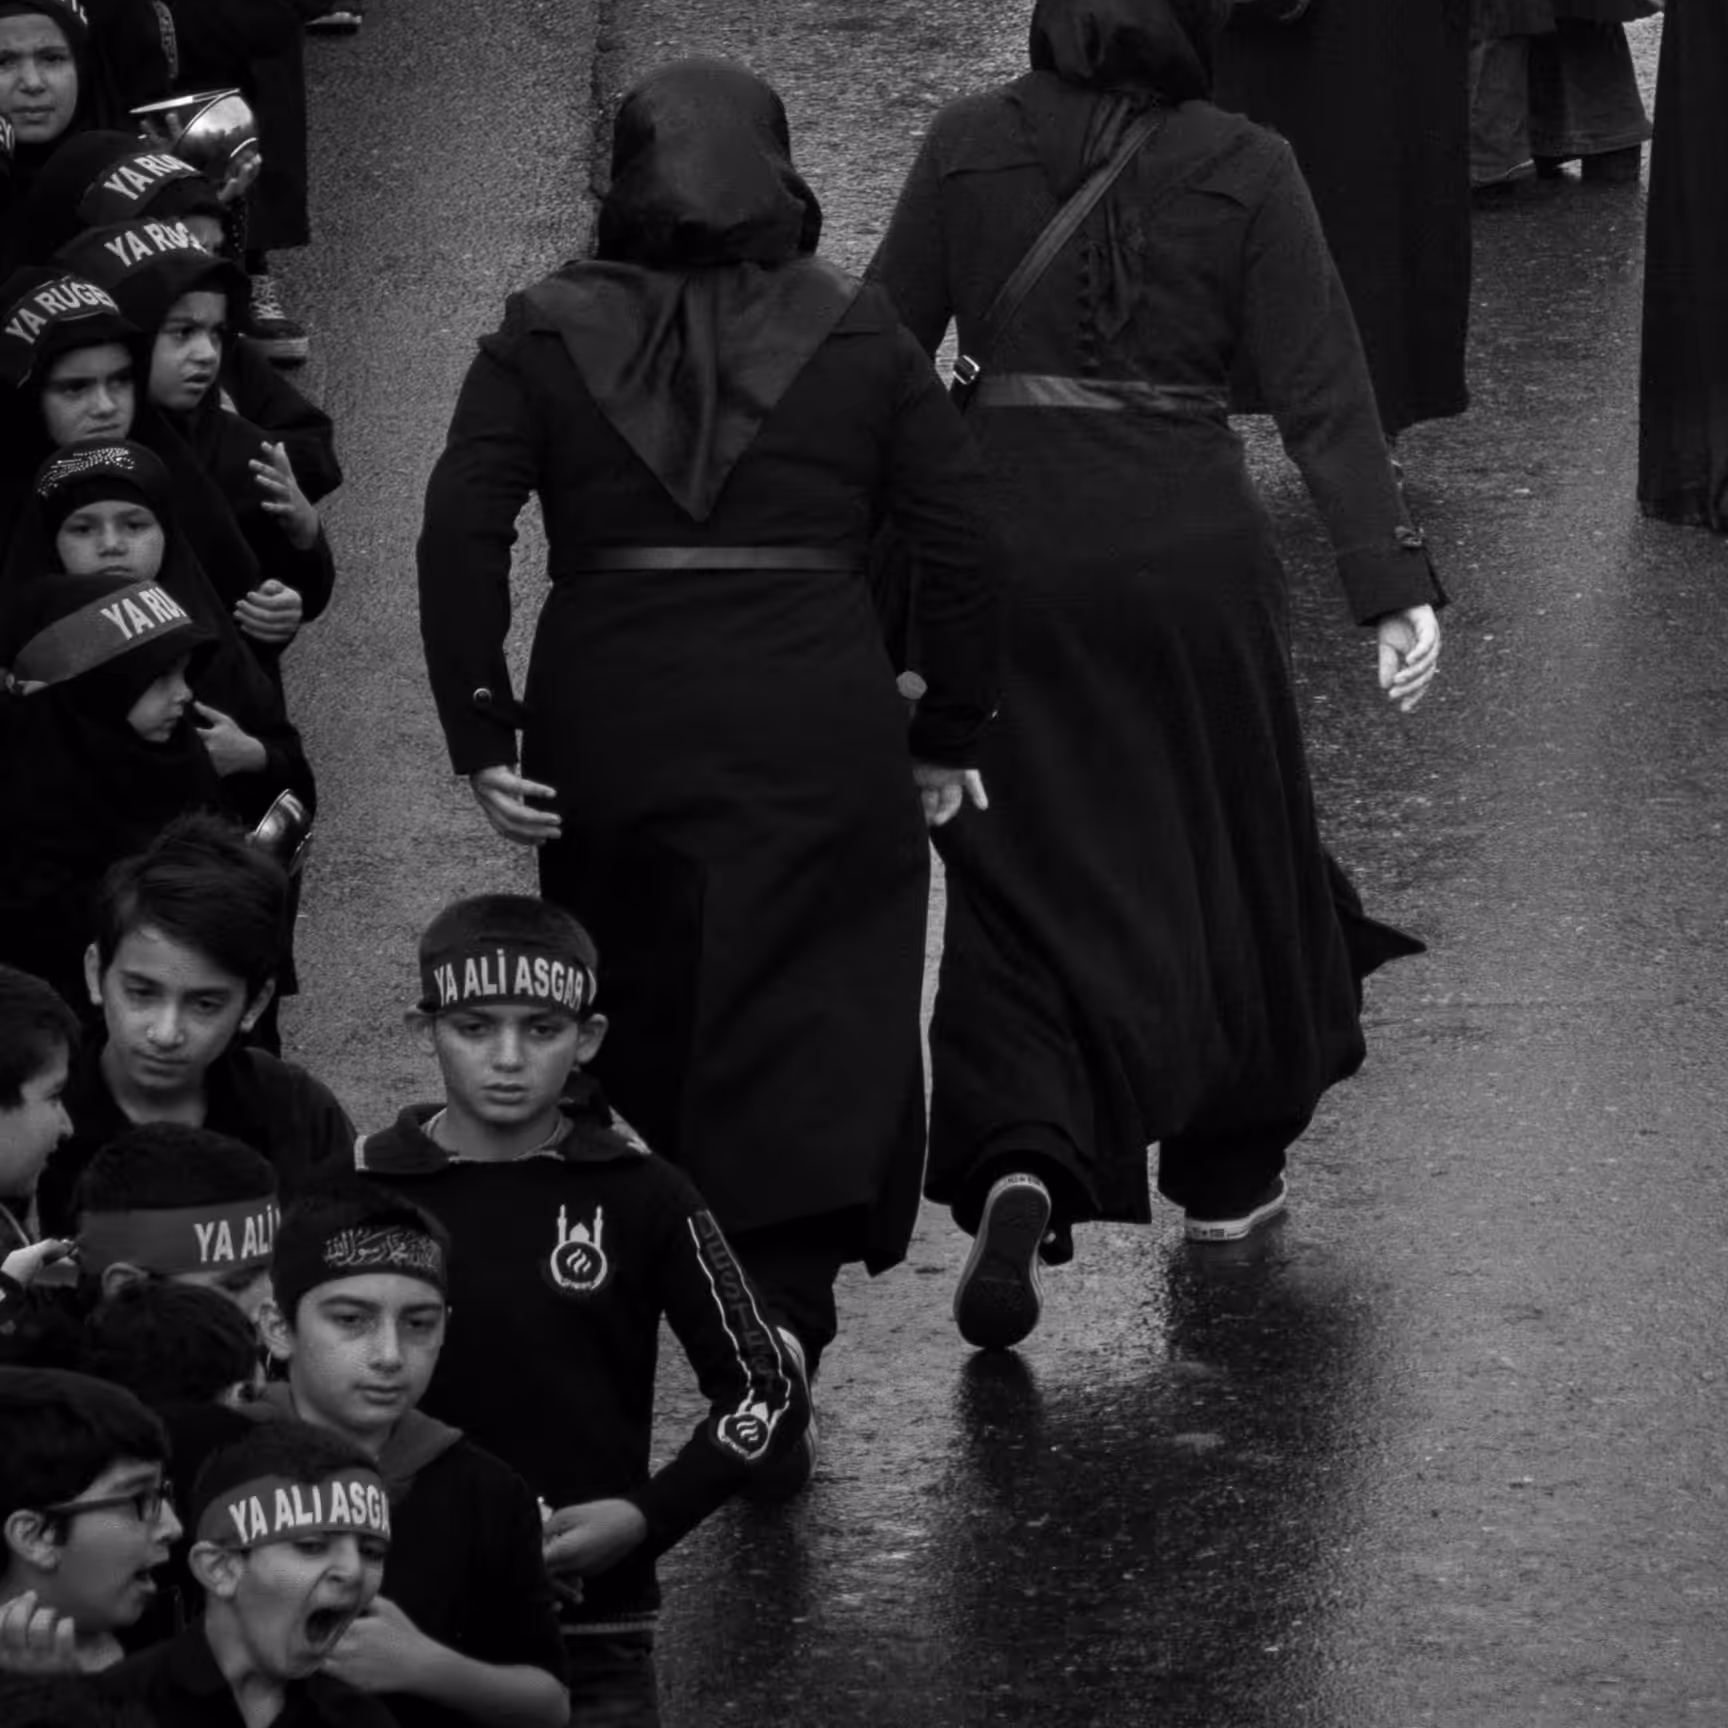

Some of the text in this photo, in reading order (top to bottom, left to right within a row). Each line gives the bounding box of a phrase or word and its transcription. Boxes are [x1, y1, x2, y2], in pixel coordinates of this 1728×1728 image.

[104, 165, 150, 201] YA
[104, 231, 152, 267] YA
[5, 311, 45, 345] YA
[100, 597, 155, 641] YA
[434, 948, 585, 1008] YA ALİ ASGAR
[195, 1220, 236, 1264] YA
[230, 1496, 267, 1542] YA
[330, 1478, 392, 1539] ASGA
